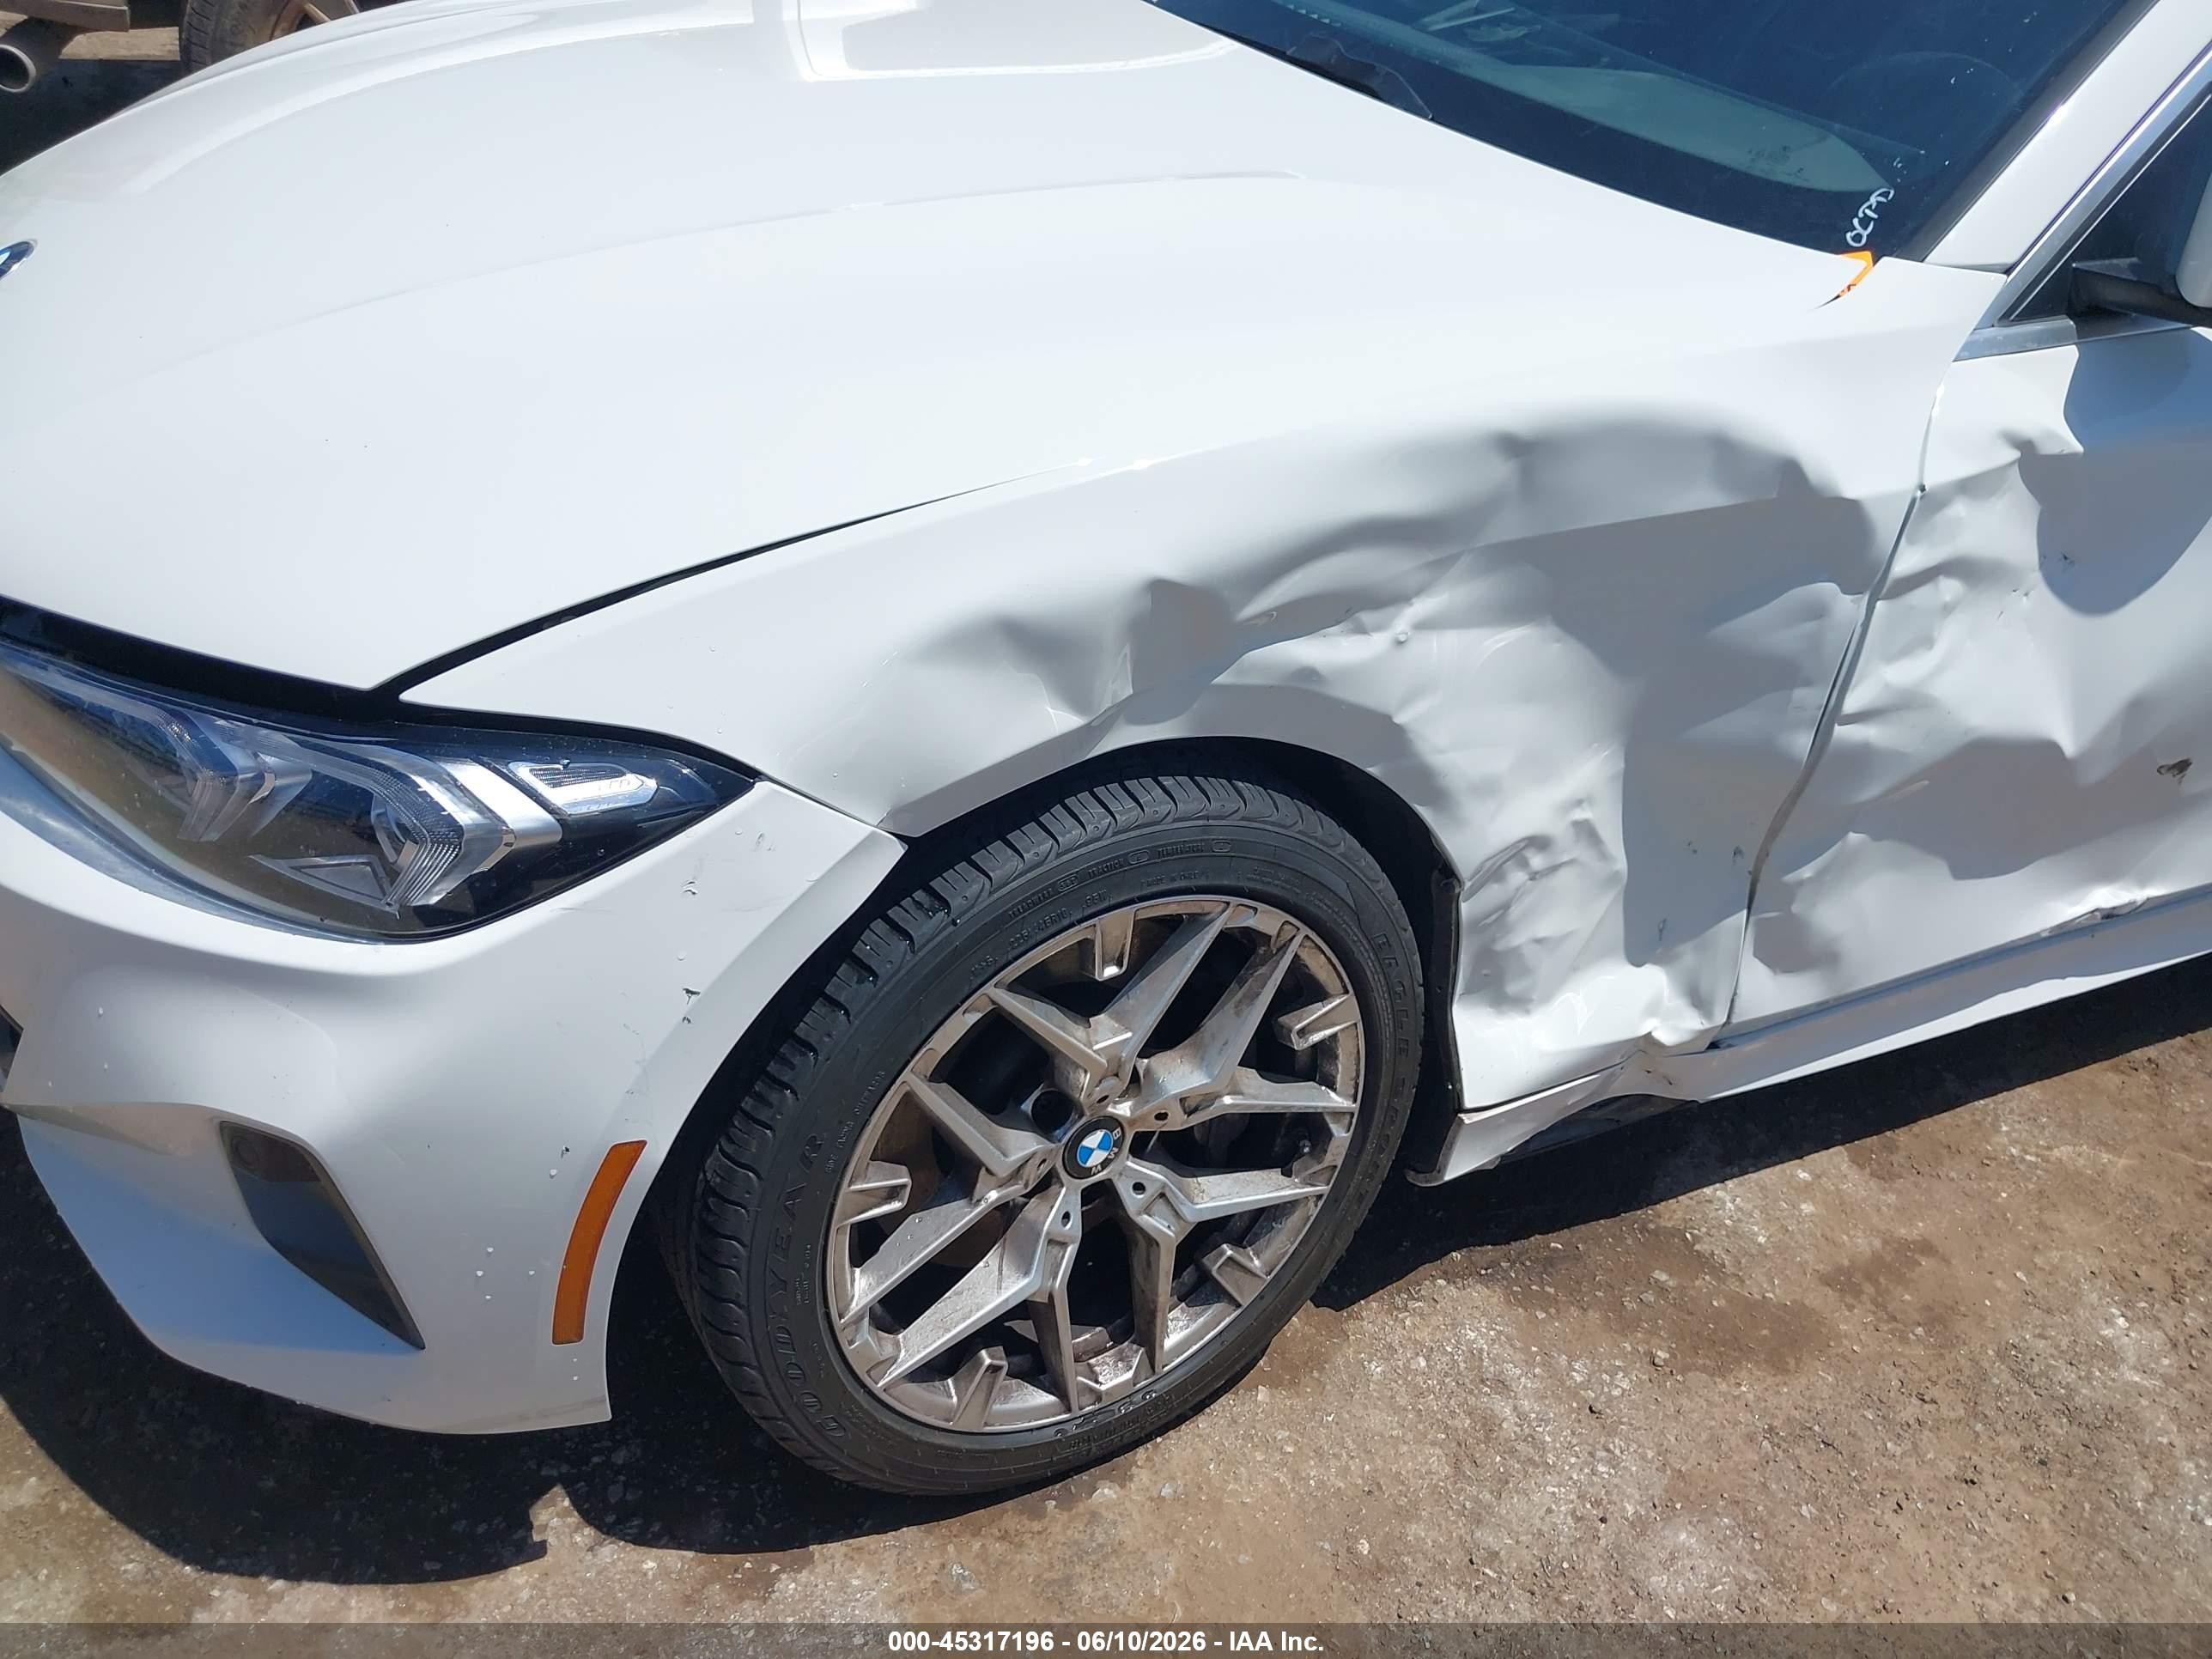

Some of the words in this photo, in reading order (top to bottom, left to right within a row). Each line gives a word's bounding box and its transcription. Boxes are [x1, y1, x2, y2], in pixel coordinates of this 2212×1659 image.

[1372, 932, 1410, 1059] EAGLE
[1091, 1127, 1121, 1175] BMW
[769, 1133, 846, 1437] GOODYEAR
